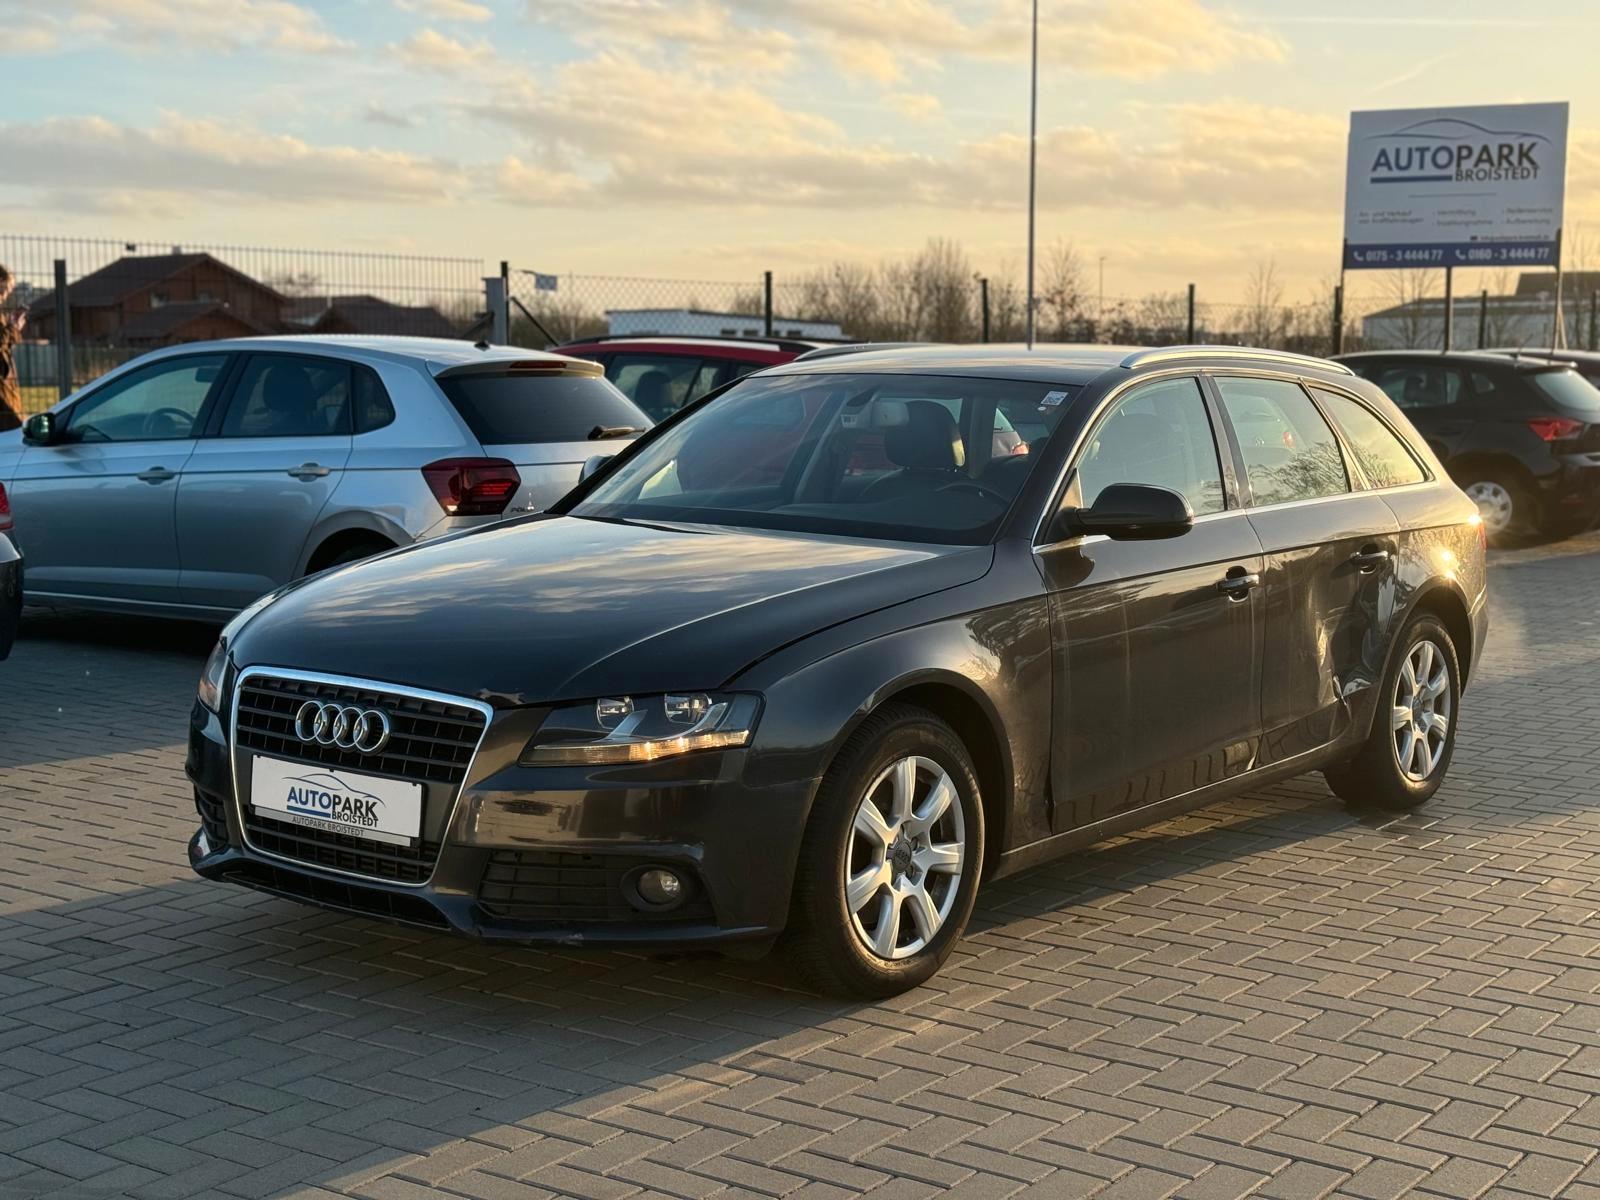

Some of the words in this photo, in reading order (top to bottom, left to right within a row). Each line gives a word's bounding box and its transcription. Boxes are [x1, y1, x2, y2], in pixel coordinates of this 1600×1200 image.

[1371, 142, 1539, 172] AUTOPARK
[1455, 167, 1539, 182] BROISTEDT
[287, 786, 378, 819] AUTOPARK
[292, 816, 327, 830] AUTOPARK
[327, 821, 364, 837] BROISTEDT
[332, 810, 378, 828] BROISTEDT
